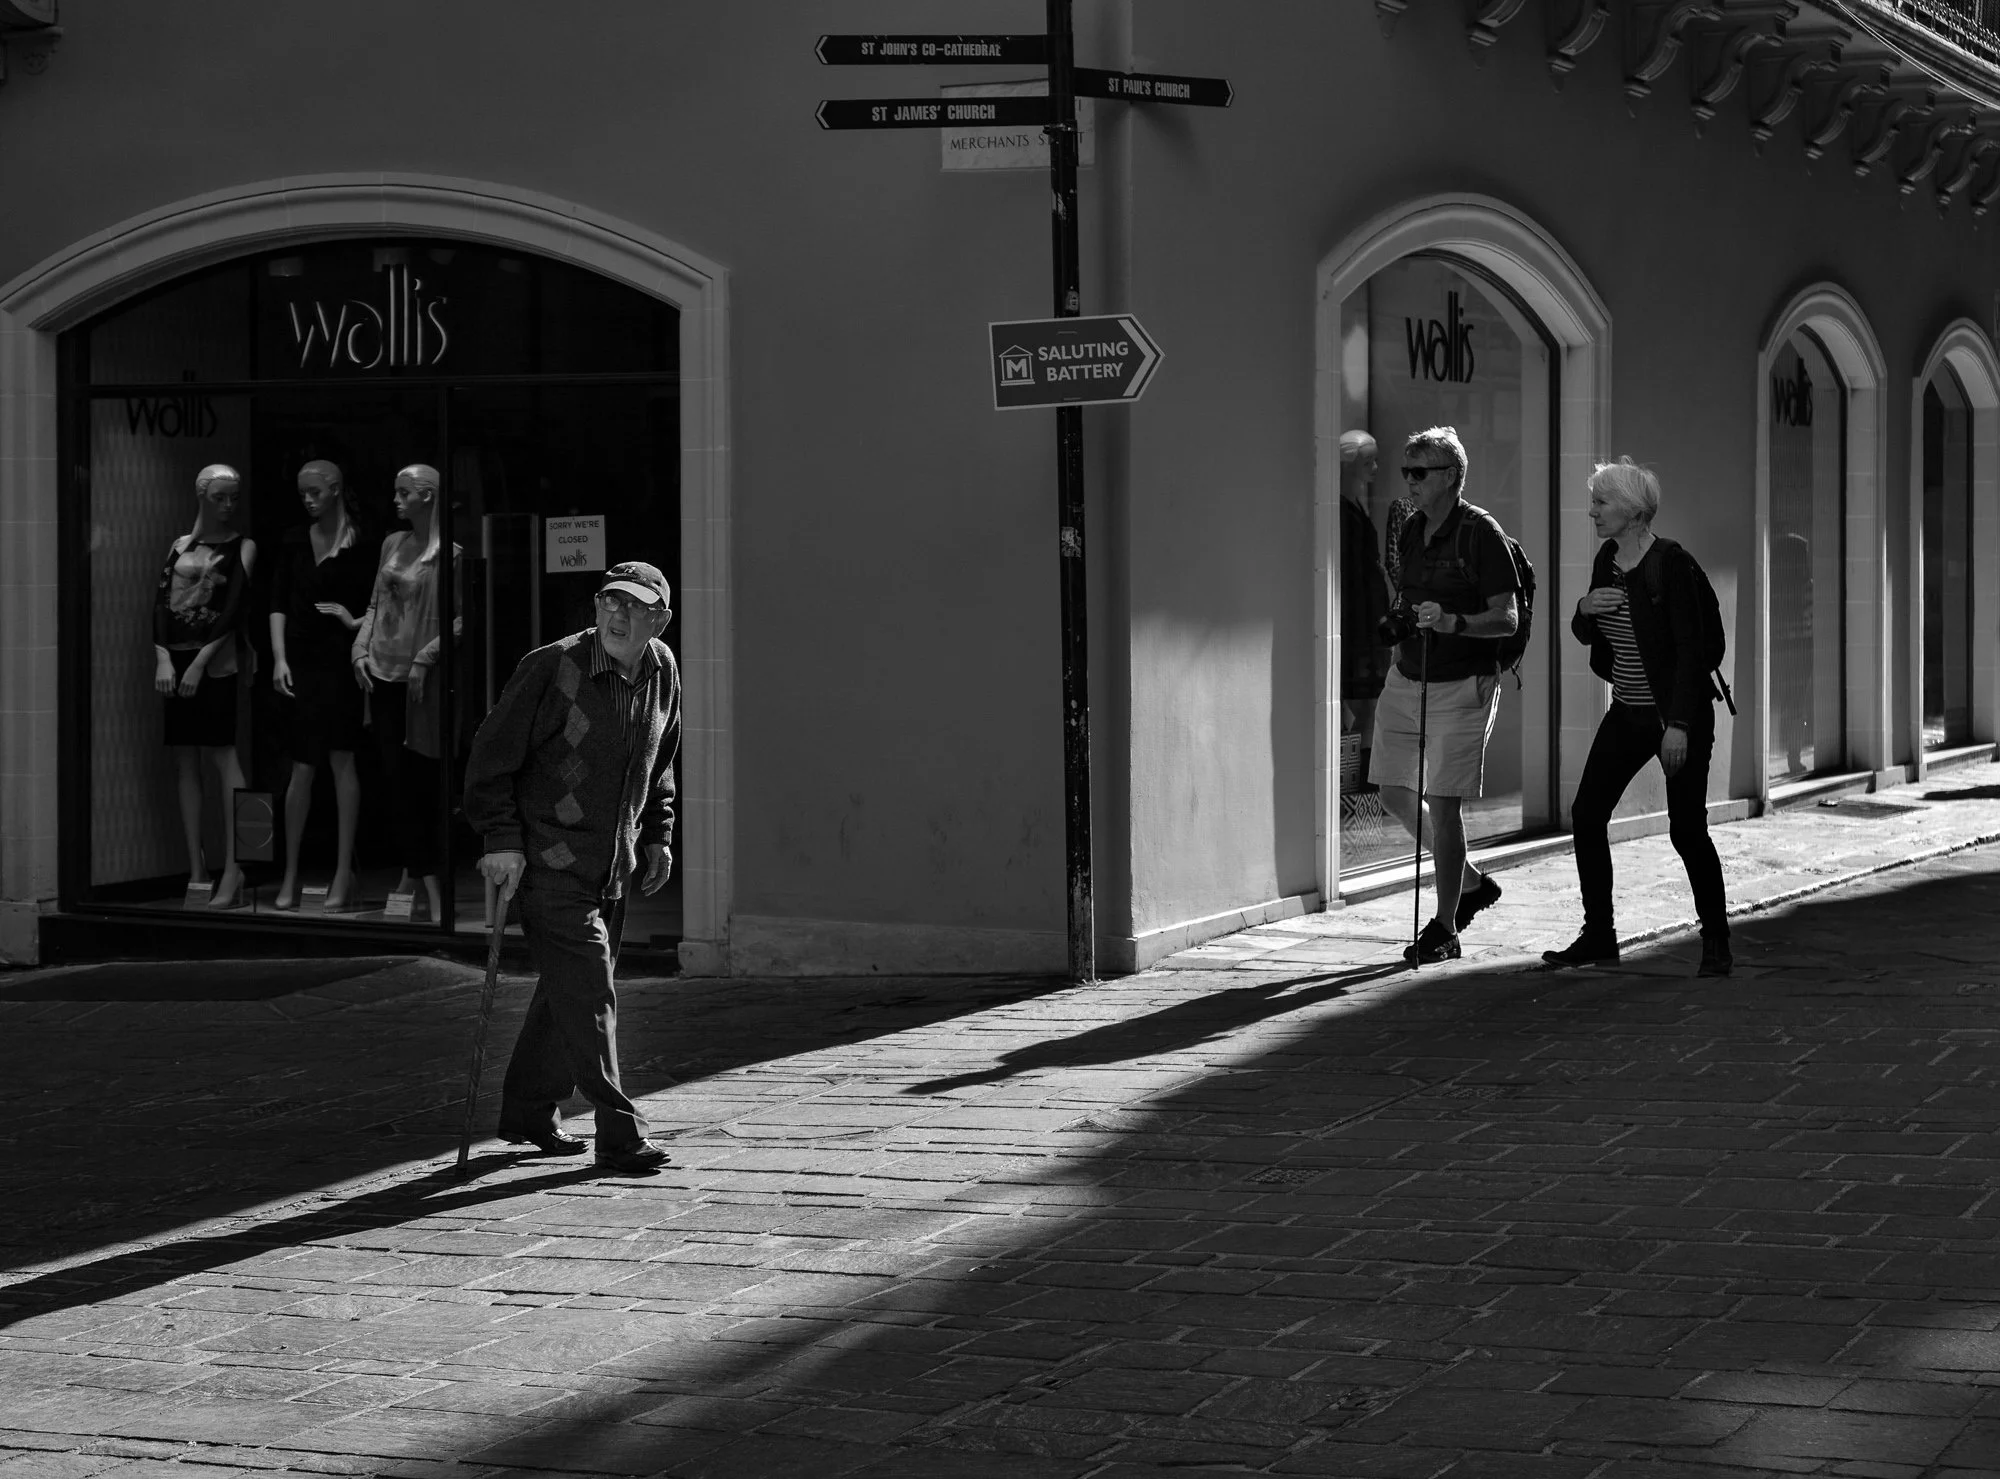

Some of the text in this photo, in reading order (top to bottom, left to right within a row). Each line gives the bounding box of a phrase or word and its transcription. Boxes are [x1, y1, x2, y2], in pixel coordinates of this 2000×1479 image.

[861, 42, 1002, 57] ST JOHN'S CO-CATHEDRAL
[1108, 77, 1191, 99] ST PAUL'S CHURCH
[871, 104, 996, 121] ST JAMES' CHURCH
[950, 134, 1030, 150] MERCHANTS
[289, 263, 449, 370] wallis
[1405, 290, 1475, 383] wallis
[1037, 341, 1129, 361] SALUTING
[1046, 362, 1124, 382] BATTERY
[549, 520, 600, 530] SORRY WE'RE
[558, 535, 589, 544] CLOSED
